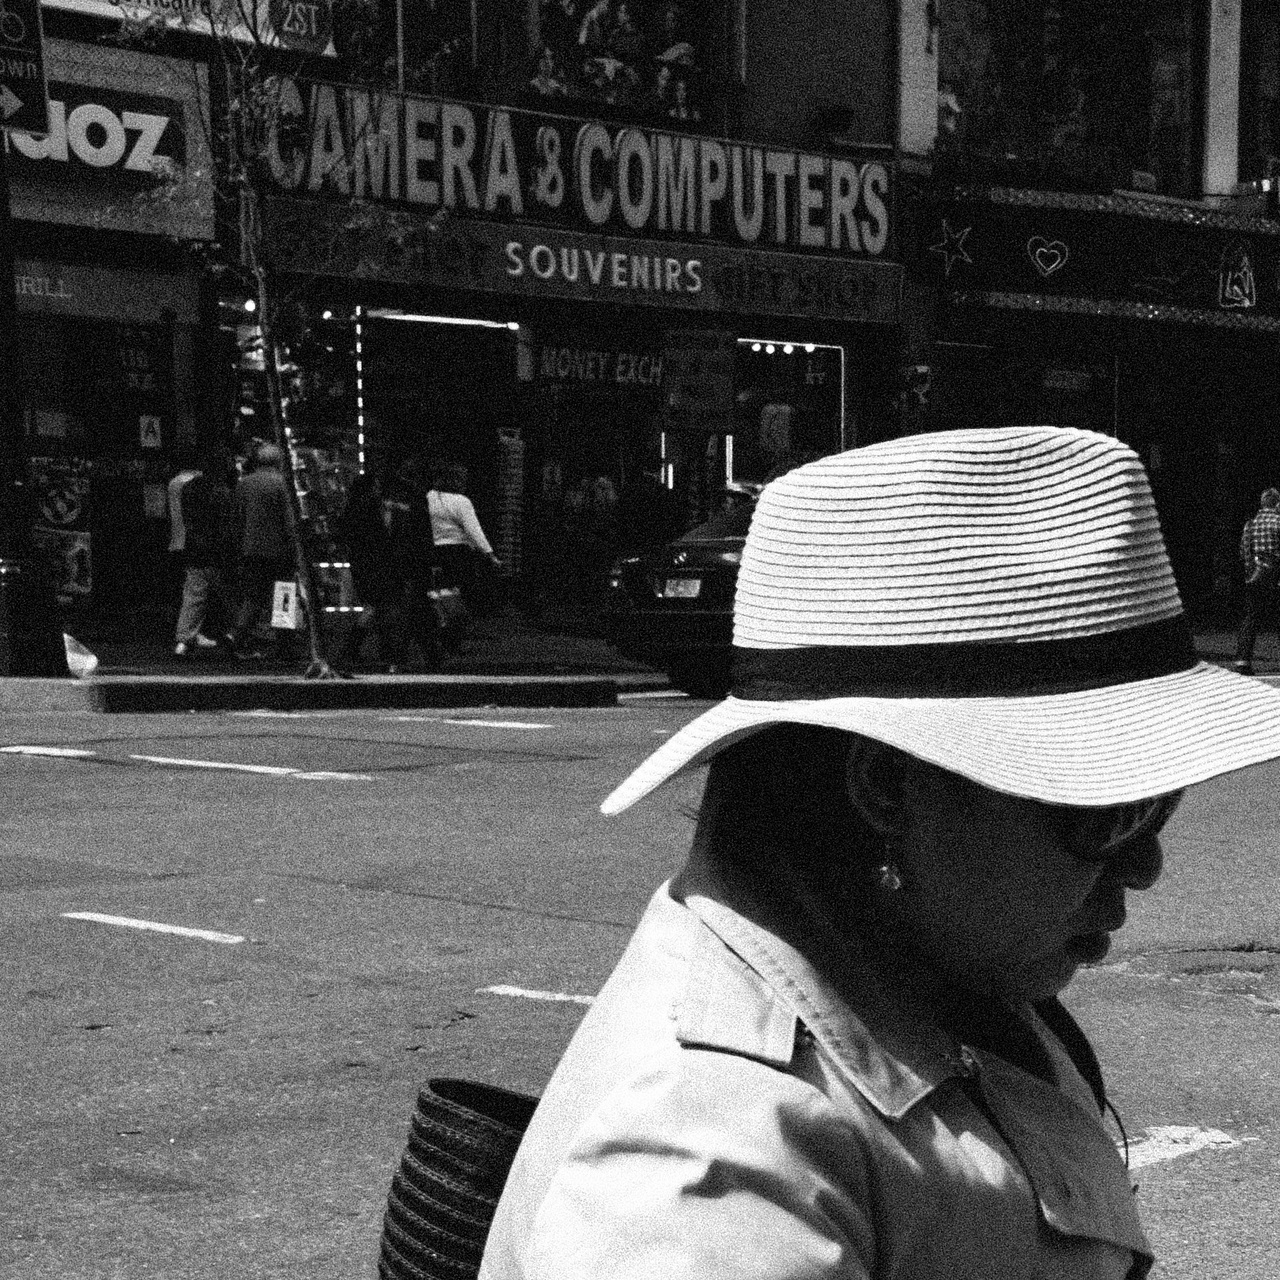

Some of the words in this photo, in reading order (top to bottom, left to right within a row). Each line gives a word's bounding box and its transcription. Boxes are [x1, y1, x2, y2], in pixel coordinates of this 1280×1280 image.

[263, 74, 523, 214] CAMERA
[534, 126, 565, 208] &
[574, 122, 890, 254] COMPUTERS
[505, 241, 703, 293] SOUVENIRS
